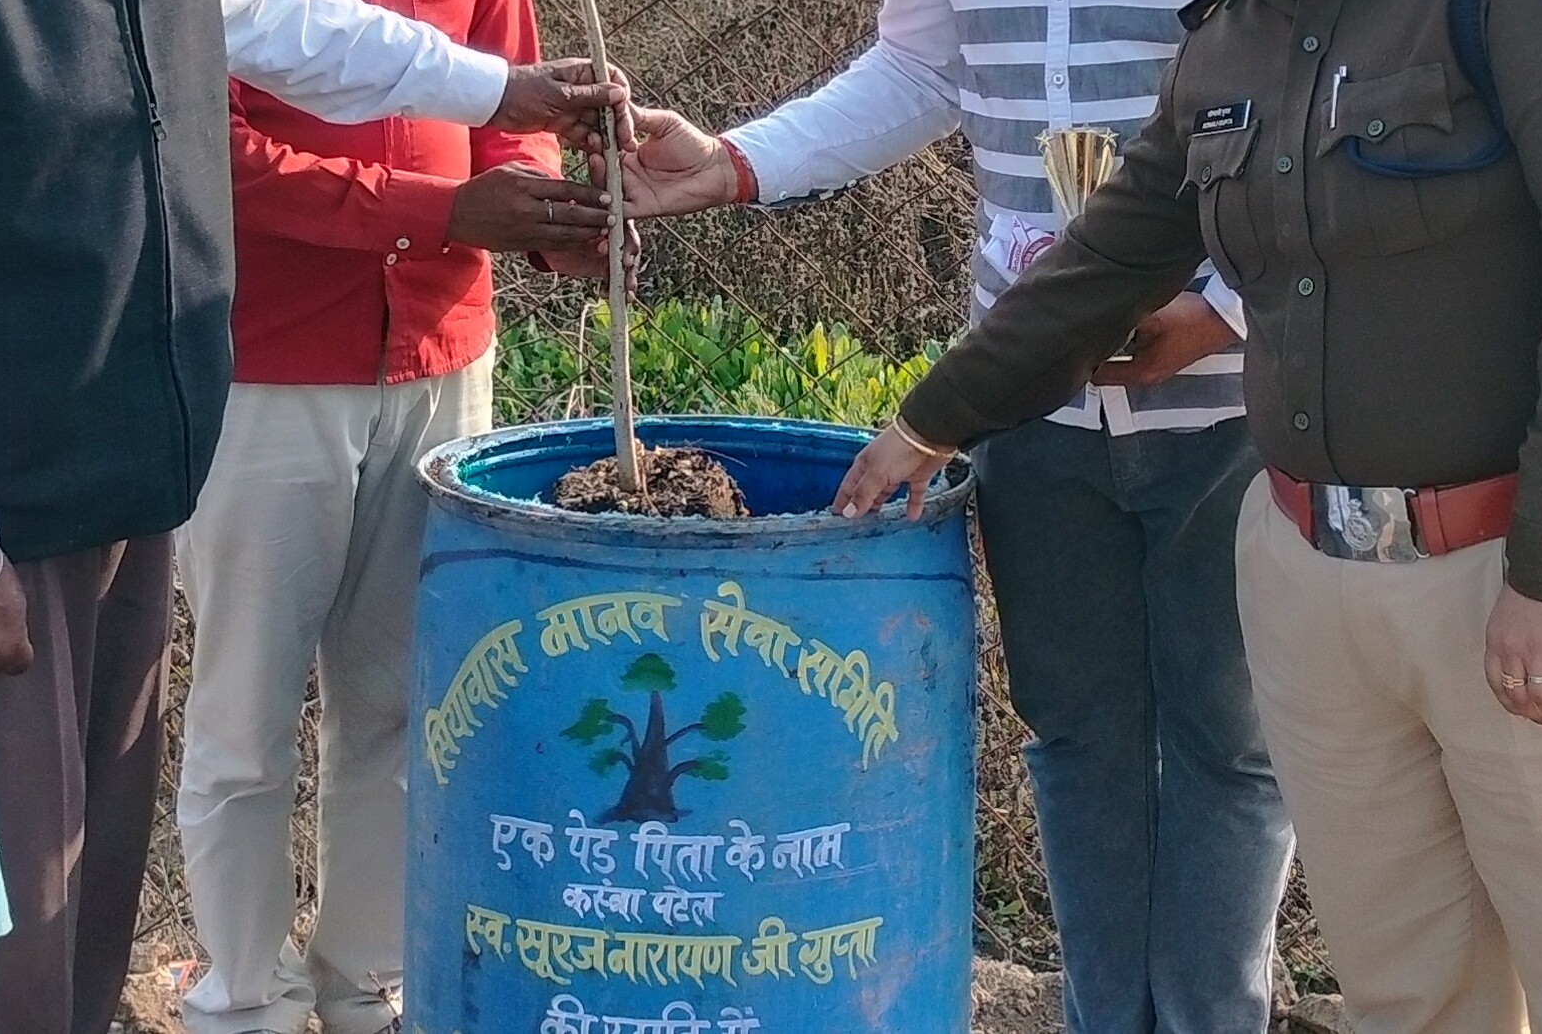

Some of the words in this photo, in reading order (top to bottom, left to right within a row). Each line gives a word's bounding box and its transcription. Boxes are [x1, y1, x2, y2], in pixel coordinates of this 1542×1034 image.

[536, 591, 682, 656] मानव
[700, 580, 802, 678] सेवा
[797, 638, 899, 772] समिति
[490, 814, 555, 870] एक
[630, 820, 724, 884] पिता
[725, 819, 765, 882] के
[772, 822, 851, 878] नाम
[466, 904, 512, 963] स्व.
[741, 916, 797, 981] जी
[798, 916, 884, 984] गुप्ता
